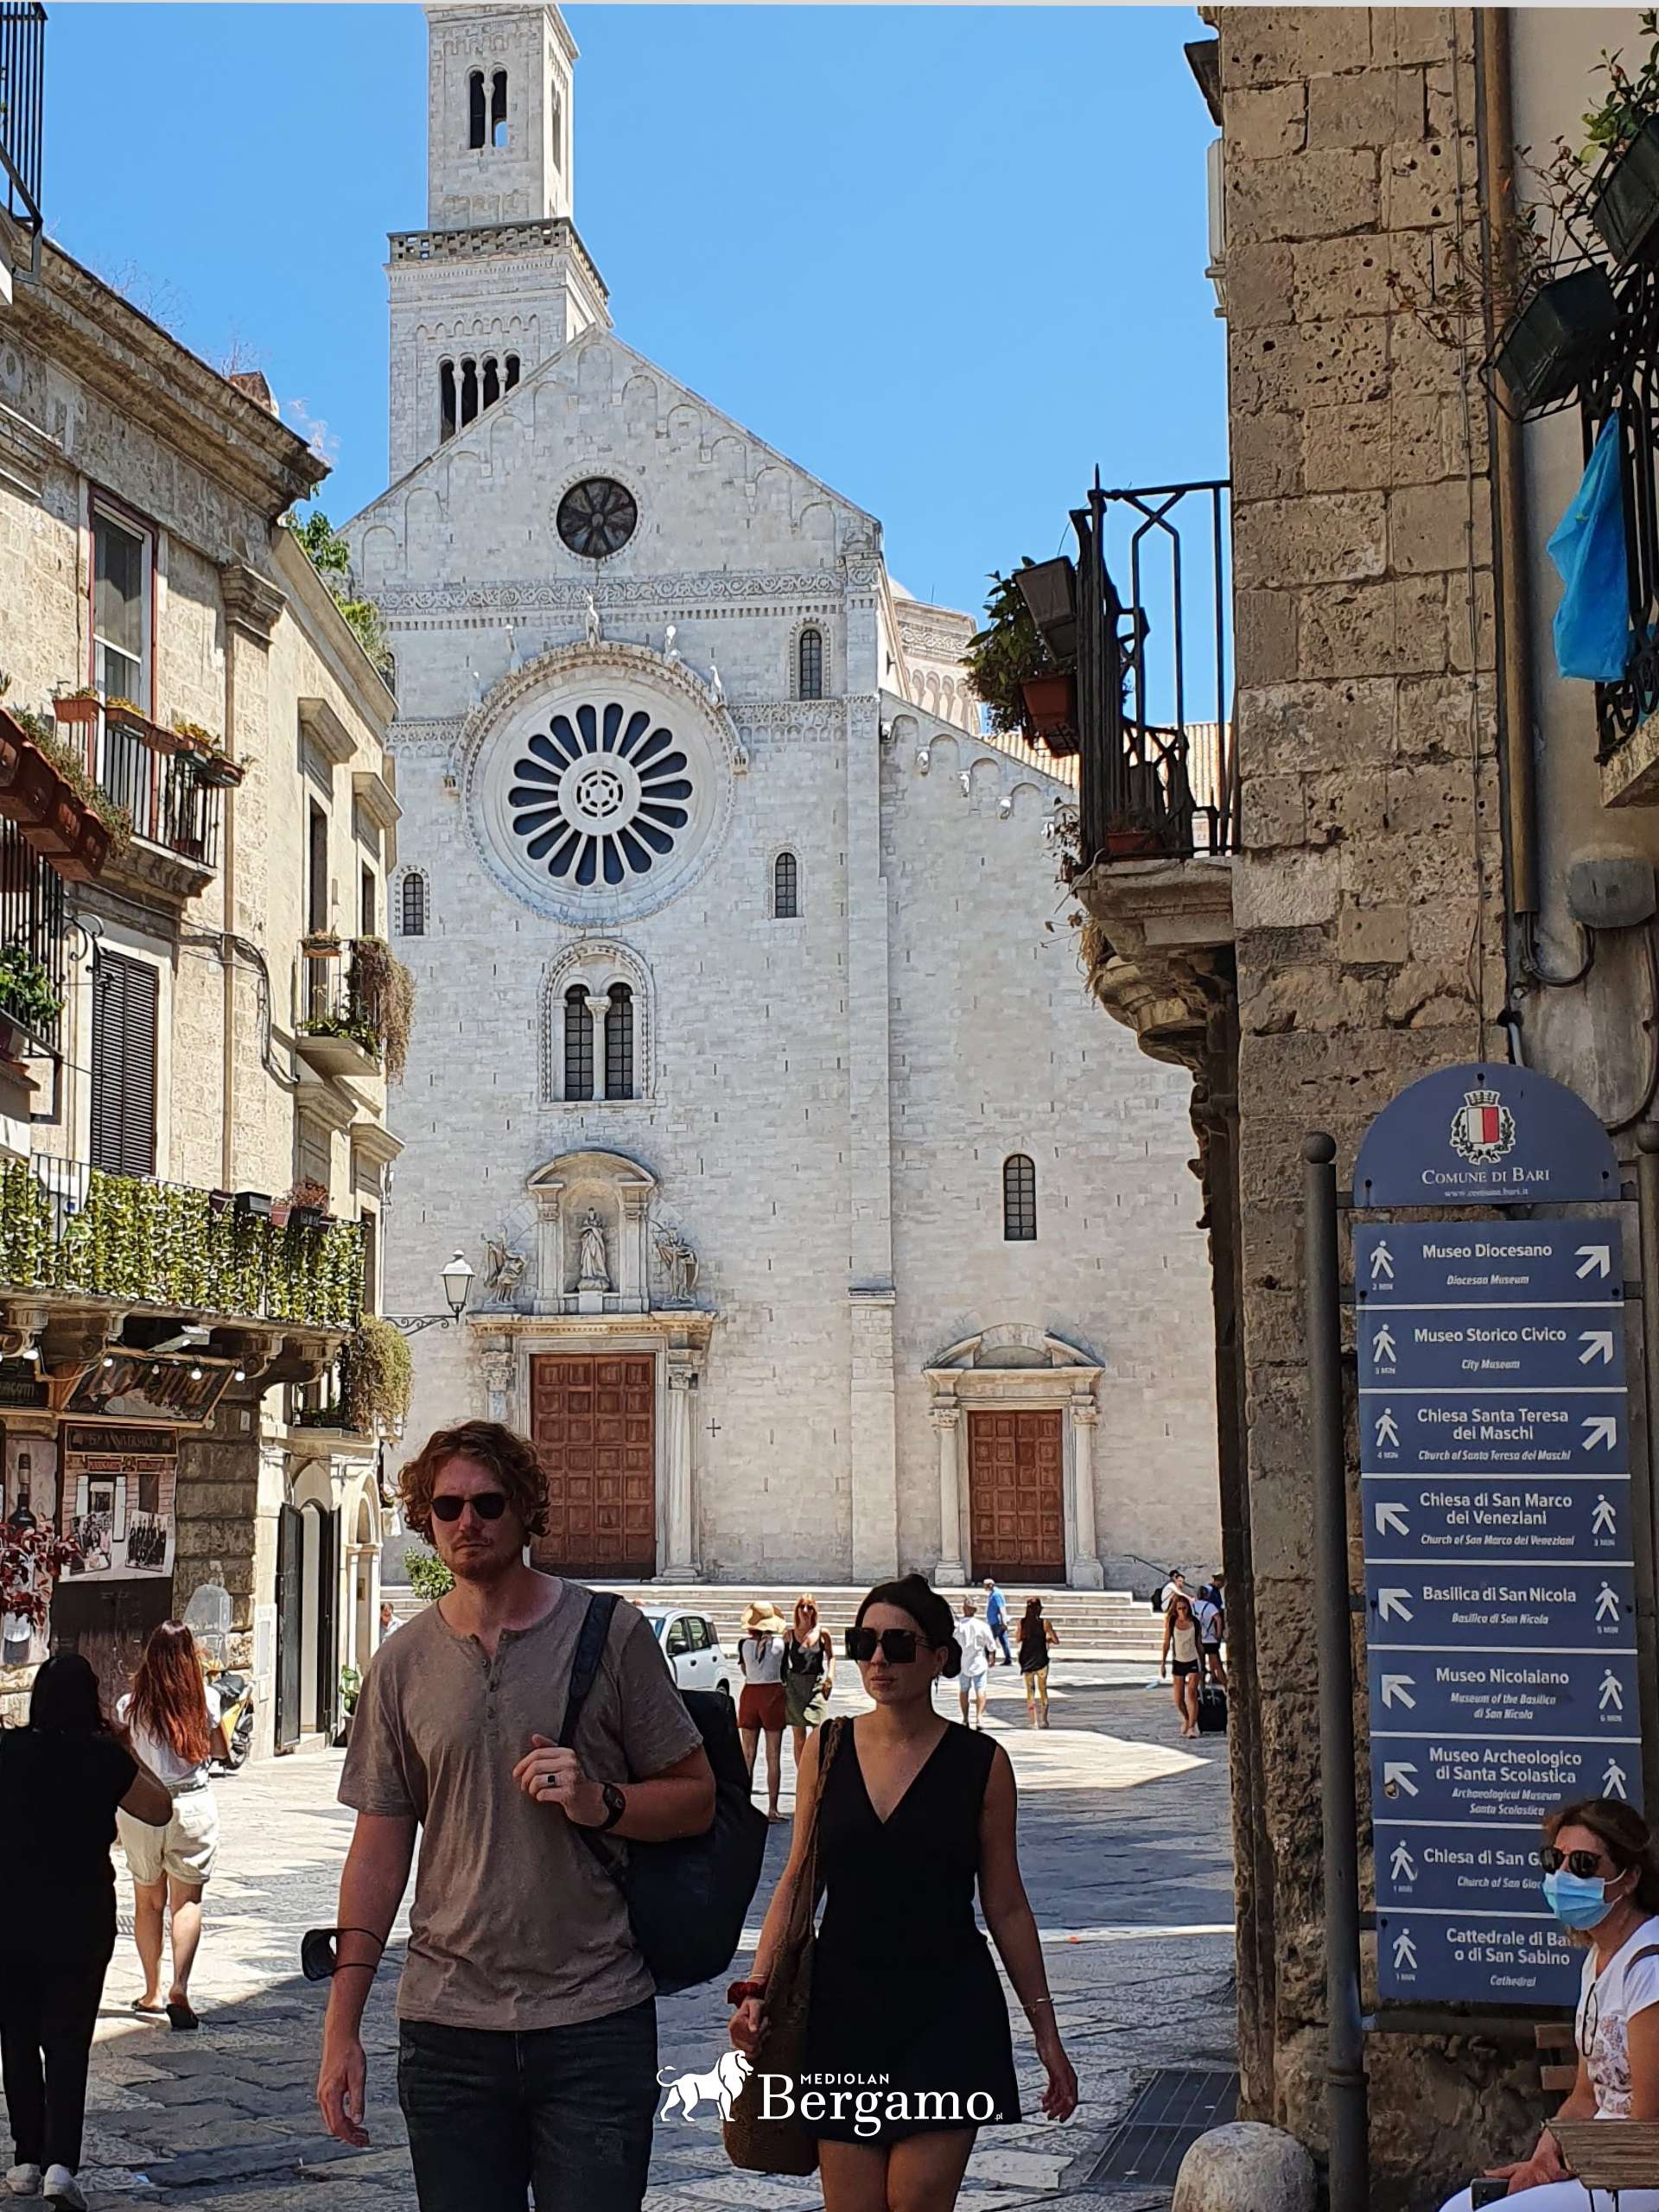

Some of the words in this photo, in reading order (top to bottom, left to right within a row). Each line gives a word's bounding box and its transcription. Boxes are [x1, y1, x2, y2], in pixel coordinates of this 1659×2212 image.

[1422, 1170, 1486, 1184] COMUNE
[1492, 1172, 1506, 1182] DI
[1513, 1167, 1548, 1181] BARI
[1423, 1245, 1471, 1258] Museo
[1475, 1243, 1552, 1257] Diocesano
[1447, 1275, 1488, 1285] Diocesan
[1491, 1274, 1529, 1284] Museum
[1415, 1329, 1463, 1342] Museo
[1467, 1328, 1517, 1341] Storico
[1522, 1327, 1566, 1341] Civico
[1462, 1360, 1479, 1371] City
[1481, 1359, 1520, 1369] Museum
[1418, 1408, 1467, 1422] Chiesa
[1472, 1408, 1515, 1422] Santa
[1518, 1408, 1568, 1422] Teresa
[1453, 1427, 1476, 1440] dei
[1481, 1426, 1533, 1440] Maschi
[1419, 1450, 1450, 1460] Church
[1452, 1450, 1461, 1459] of
[1462, 1450, 1489, 1459] Santa
[1491, 1450, 1520, 1460] Teresa
[1522, 1450, 1536, 1460] dei
[1538, 1450, 1571, 1460] Maschi
[1421, 1492, 1470, 1506] Chiesa
[1474, 1493, 1488, 1506] di
[1493, 1493, 1520, 1507] San
[1525, 1493, 1572, 1507] Marco
[1446, 1510, 1469, 1524] dei
[1473, 1510, 1546, 1524] Veneziani
[1421, 1535, 1452, 1544] Church
[1454, 1535, 1464, 1544] of
[1465, 1535, 1482, 1544] San
[1484, 1535, 1512, 1545] Marco
[1514, 1535, 1529, 1545] dei
[1531, 1535, 1574, 1545] Veneziani
[1423, 1586, 1479, 1600] Basilica
[1483, 1587, 1496, 1600] di
[1499, 1587, 1527, 1601] San
[1529, 1588, 1576, 1601] Nicola
[1452, 1613, 1488, 1623] Basilica
[1490, 1613, 1499, 1623] di
[1501, 1614, 1517, 1624] San
[1520, 1614, 1548, 1624] Nicola
[1437, 1668, 1485, 1682] Museo
[1490, 1669, 1569, 1683] Nicolaiano
[1451, 1693, 1490, 1703] Museum
[1491, 1694, 1502, 1704] of
[1503, 1694, 1517, 1704] the
[1520, 1694, 1555, 1705] Basilica
[1474, 1708, 1484, 1718] di
[1485, 1708, 1502, 1719] San
[1504, 1709, 1533, 1719] Nicola
[1430, 1747, 1479, 1762] Museo
[1484, 1749, 1581, 1768] Archeologico
[1436, 1765, 1449, 1779] di
[1453, 1767, 1496, 1781] Santa
[1500, 1767, 1575, 1783] Scolastica
[1452, 1788, 1520, 1800] Archaeological
[1522, 1789, 1560, 1800] Museum
[1470, 1803, 1497, 1814] Santa
[1498, 1804, 1545, 1815] Scolastica
[1424, 1848, 1473, 1864] Chiesa
[1478, 1850, 1491, 1864] di
[1497, 1851, 1523, 1866] San
[1458, 1876, 1489, 1886] Church
[1491, 1877, 1501, 1887] of
[1503, 1878, 1520, 1887] San
[1447, 1928, 1524, 1945] Cattedrale
[1529, 1932, 1542, 1945] di
[1455, 1950, 1464, 1961] o
[1468, 1948, 1481, 1961] di
[1486, 1948, 1514, 1962] San
[1518, 1949, 1569, 1965] Sabino
[1491, 1975, 1536, 1986] Cathedral
